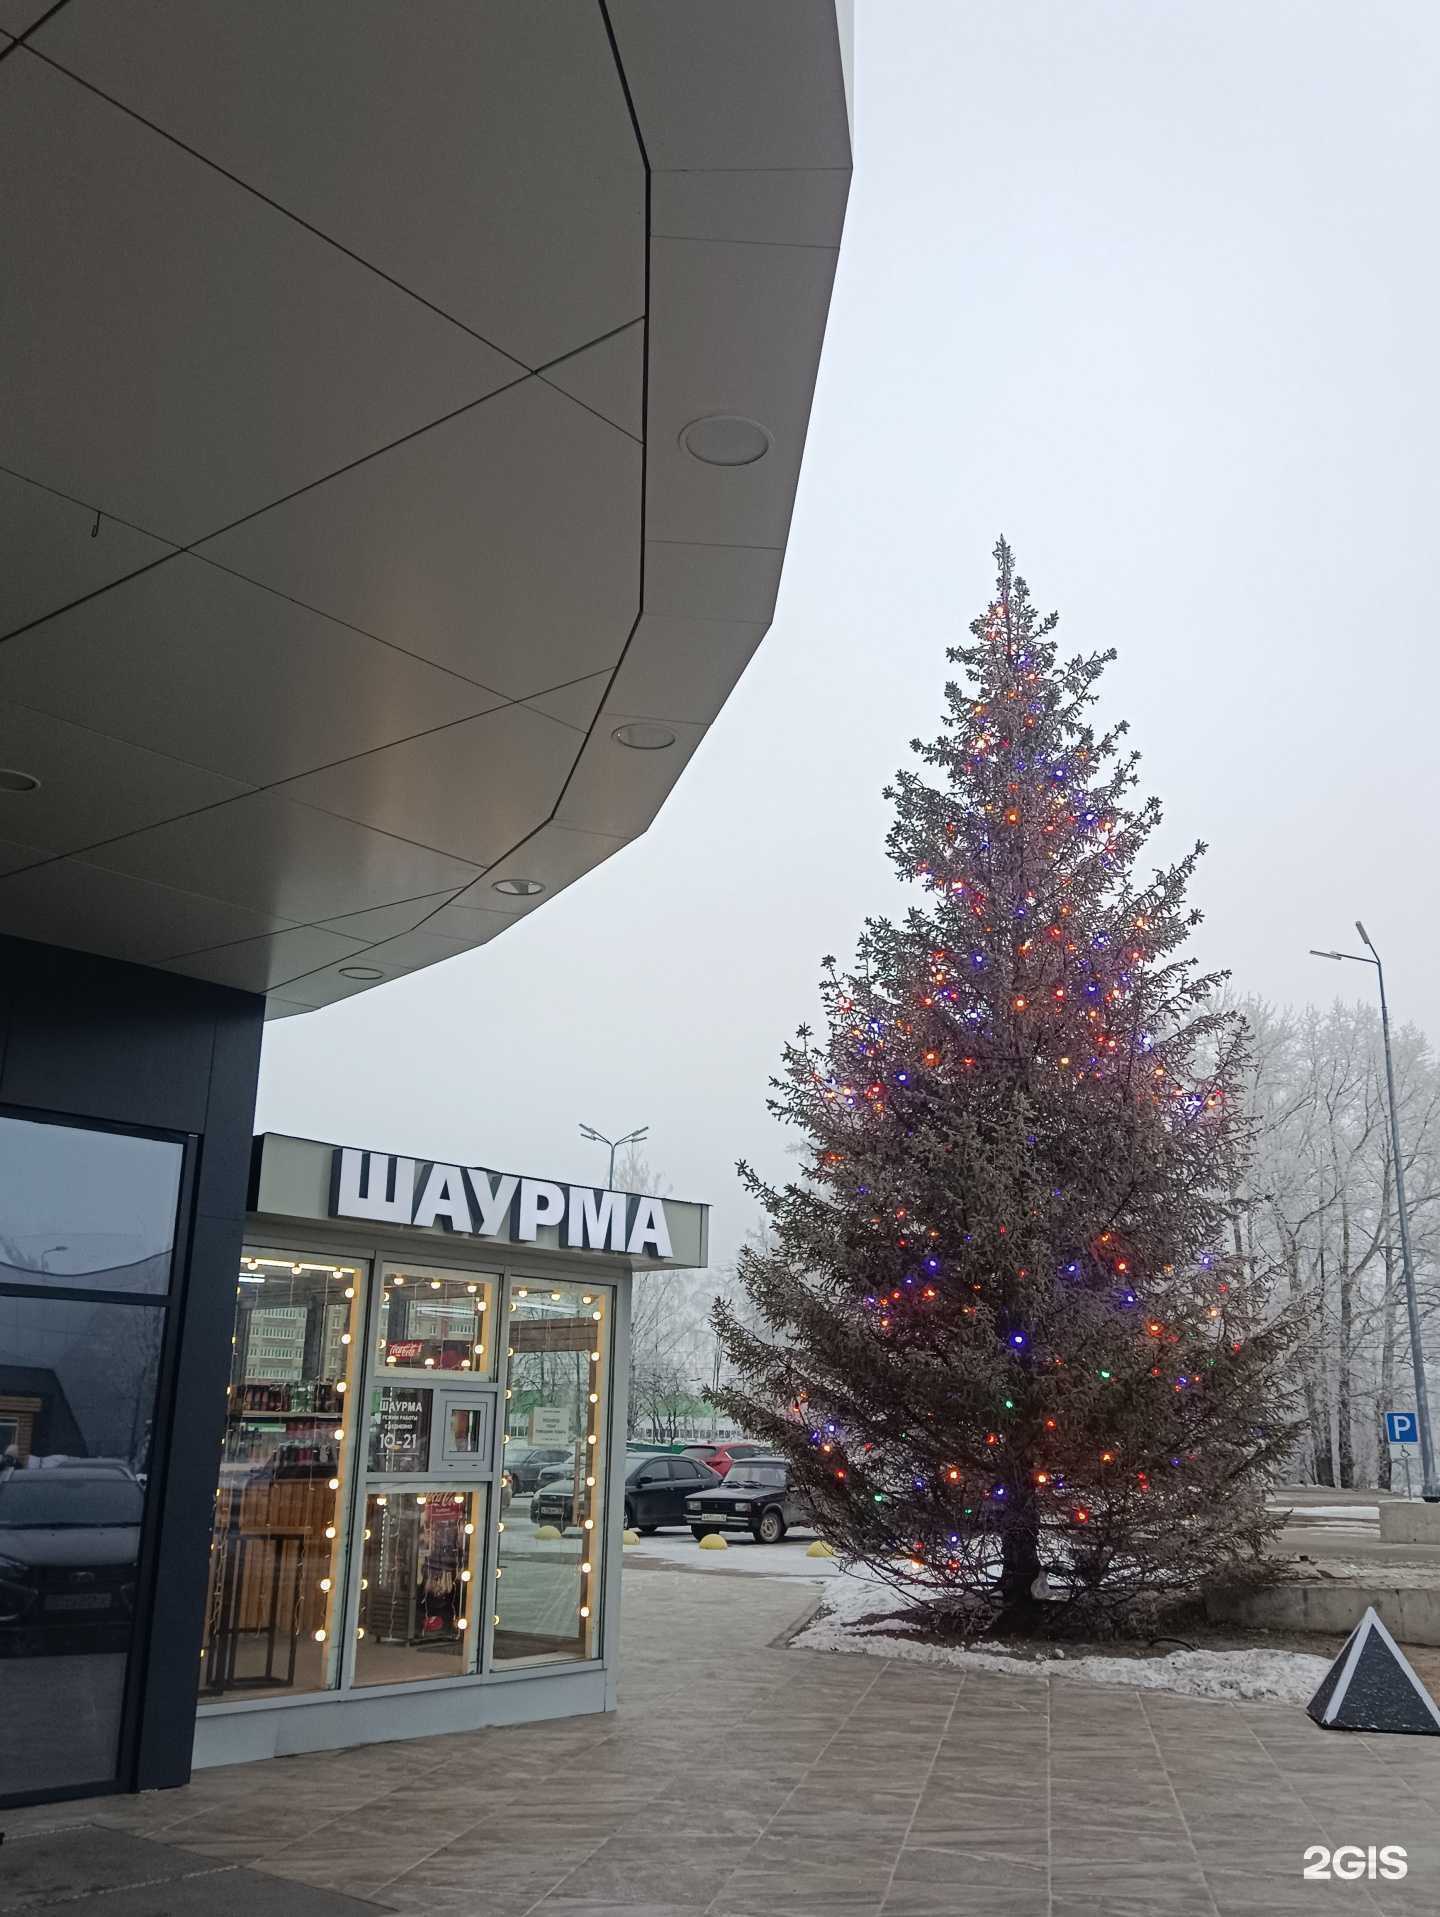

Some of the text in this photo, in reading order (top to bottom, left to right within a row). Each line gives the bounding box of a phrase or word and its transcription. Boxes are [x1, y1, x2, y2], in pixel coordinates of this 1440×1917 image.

[336, 1147, 673, 1258] ШАУРМА
[379, 1401, 423, 1412] ШАУРМА
[379, 1433, 417, 1449] 10-21
